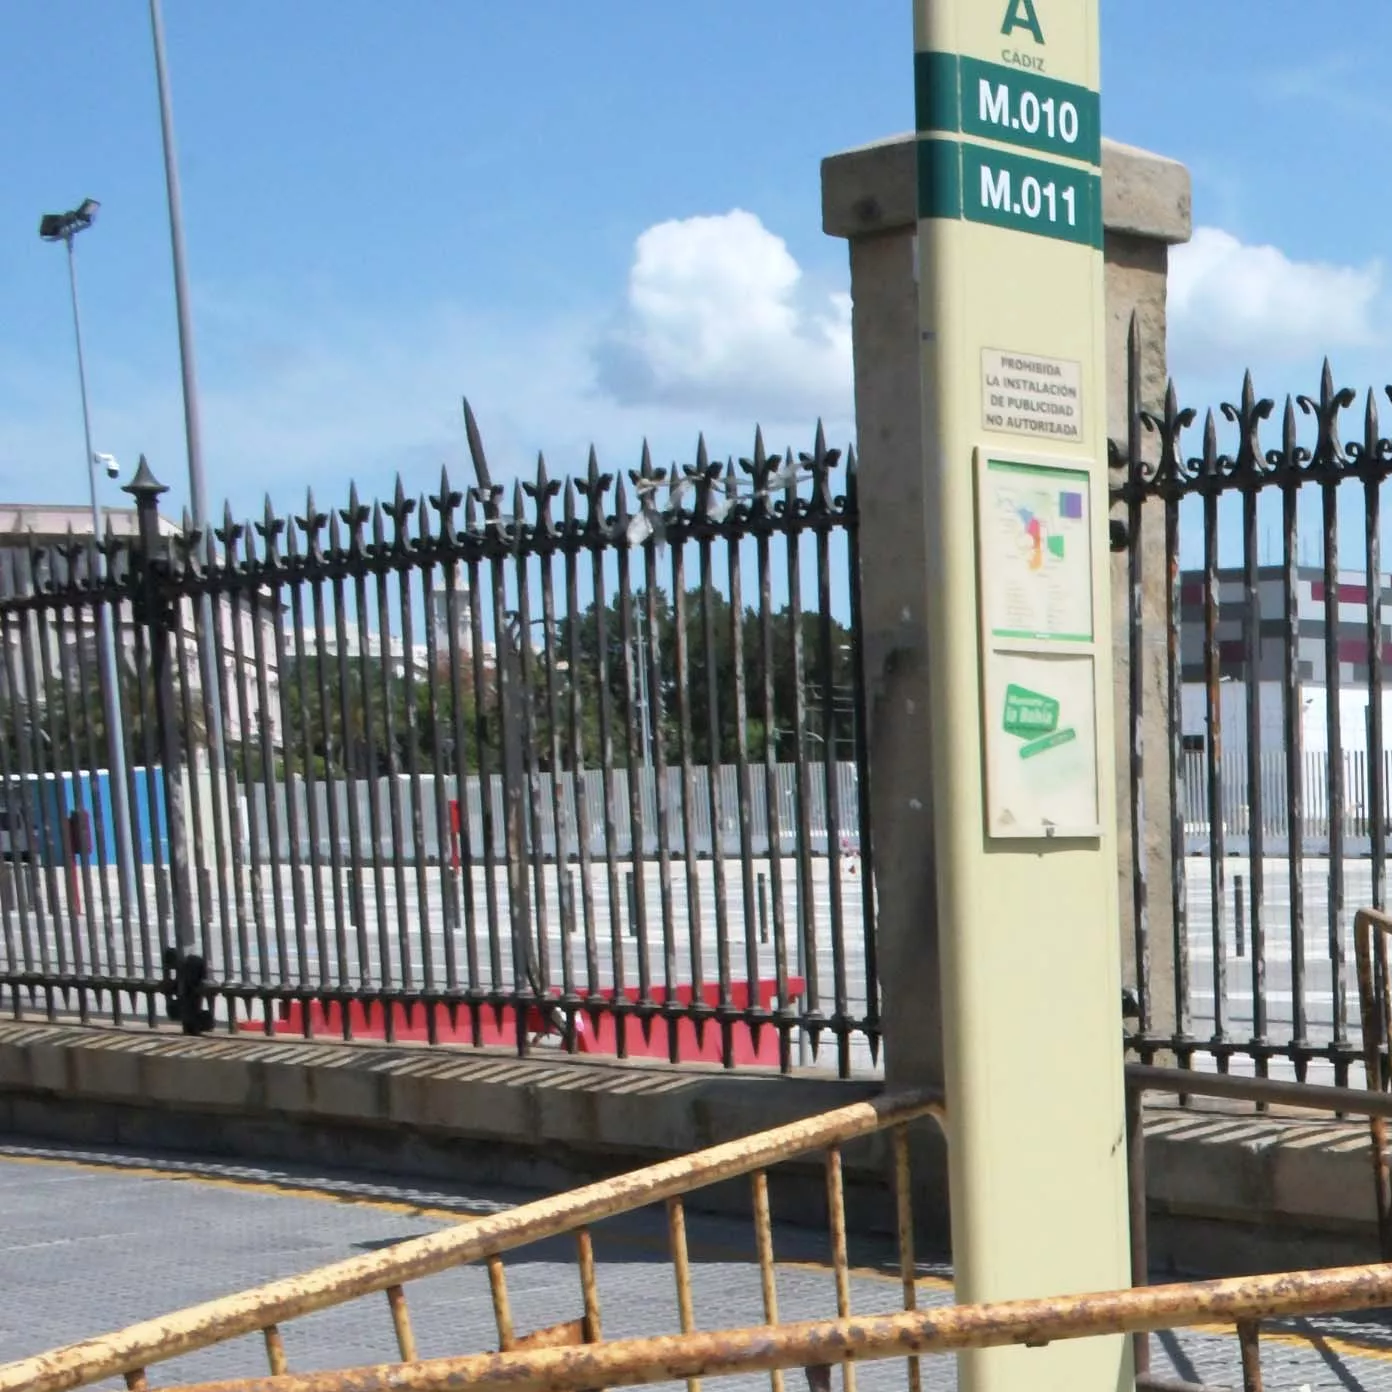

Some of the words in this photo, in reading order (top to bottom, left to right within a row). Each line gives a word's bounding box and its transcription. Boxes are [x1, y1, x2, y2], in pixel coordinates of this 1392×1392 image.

[1000, 0, 1045, 45] A
[1001, 48, 1046, 72] CÁDIZ
[978, 78, 1079, 144] M.010
[980, 164, 1076, 227] M.011
[1001, 356, 1061, 377] PROHIBIDA
[986, 375, 1000, 386] LA
[990, 394, 1004, 407] DE
[1007, 396, 1074, 417] PUBLICIDAD
[986, 414, 1003, 426] NO
[1007, 416, 1078, 436] AUTORIZADA
